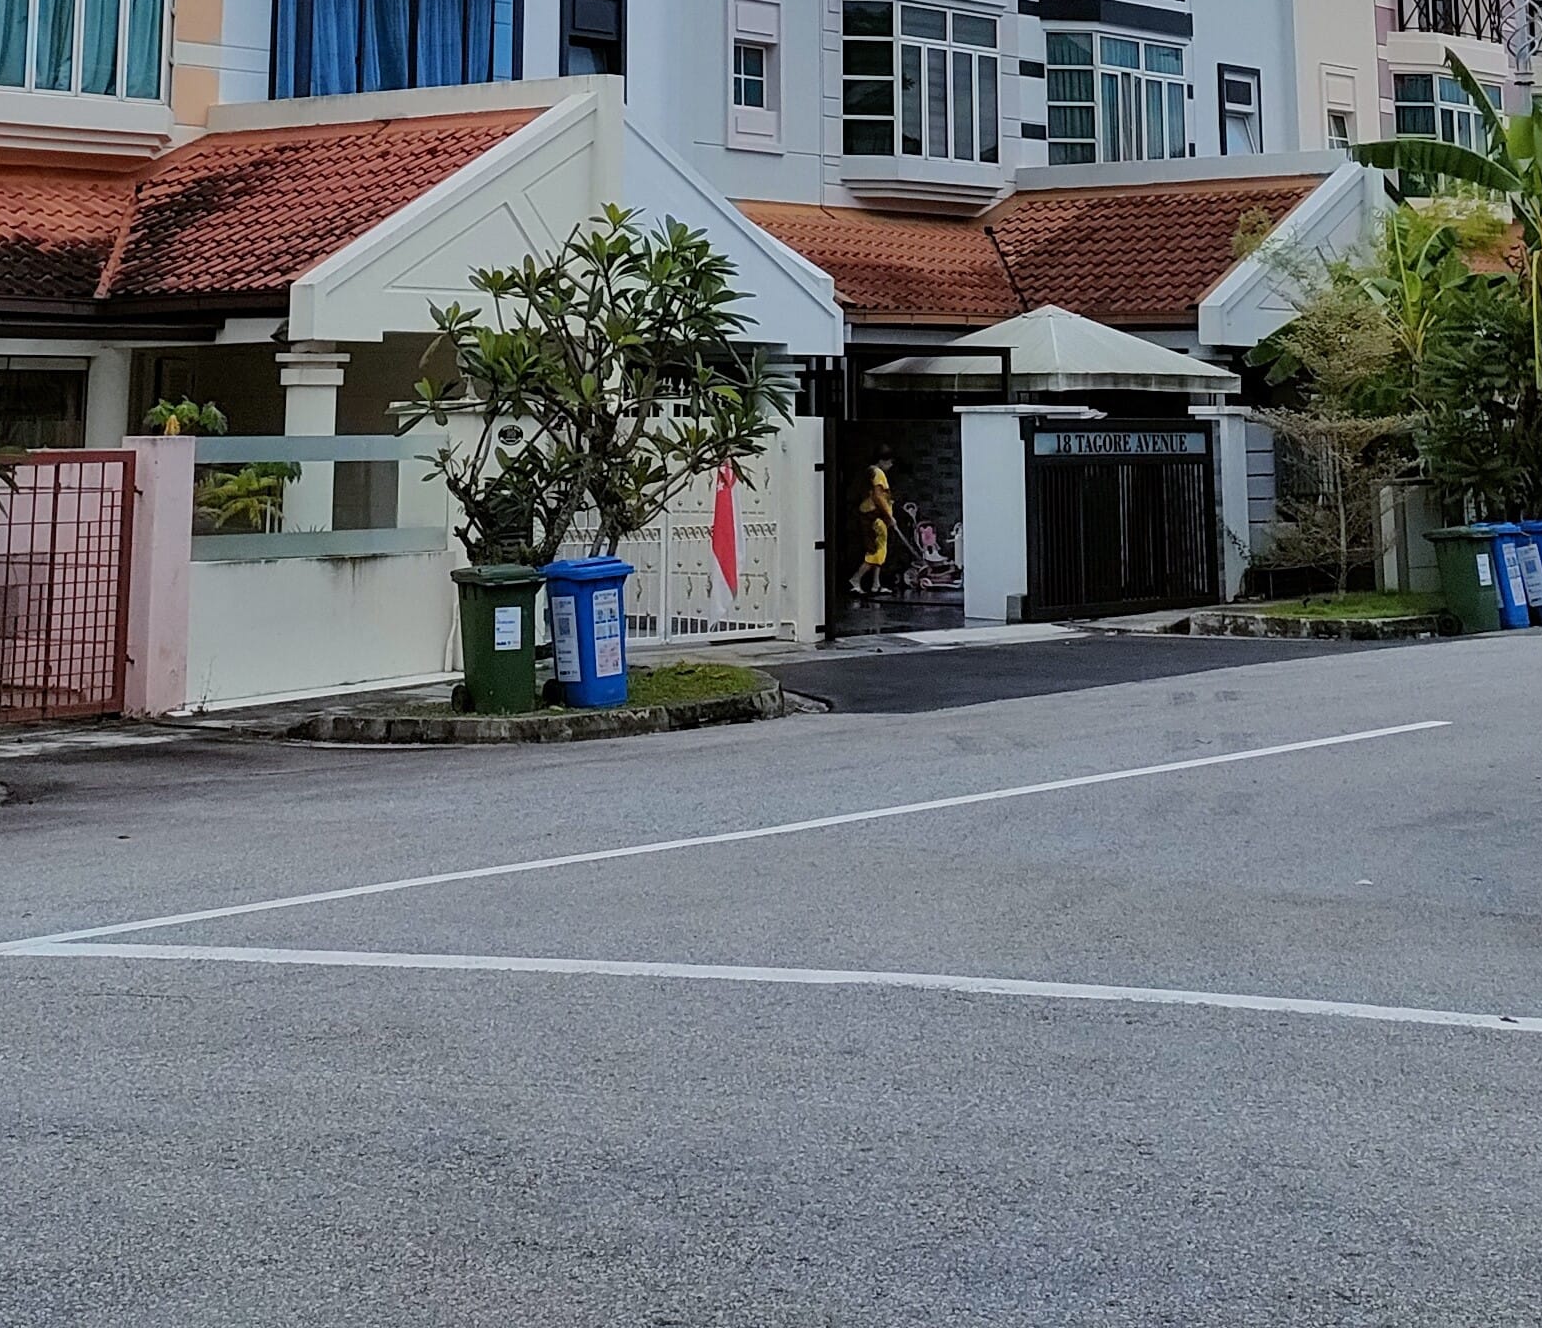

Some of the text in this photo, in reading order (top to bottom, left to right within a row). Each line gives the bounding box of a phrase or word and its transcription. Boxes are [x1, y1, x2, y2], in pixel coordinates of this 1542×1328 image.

[1055, 433, 1188, 454] 18 TAGORE AVENUE
